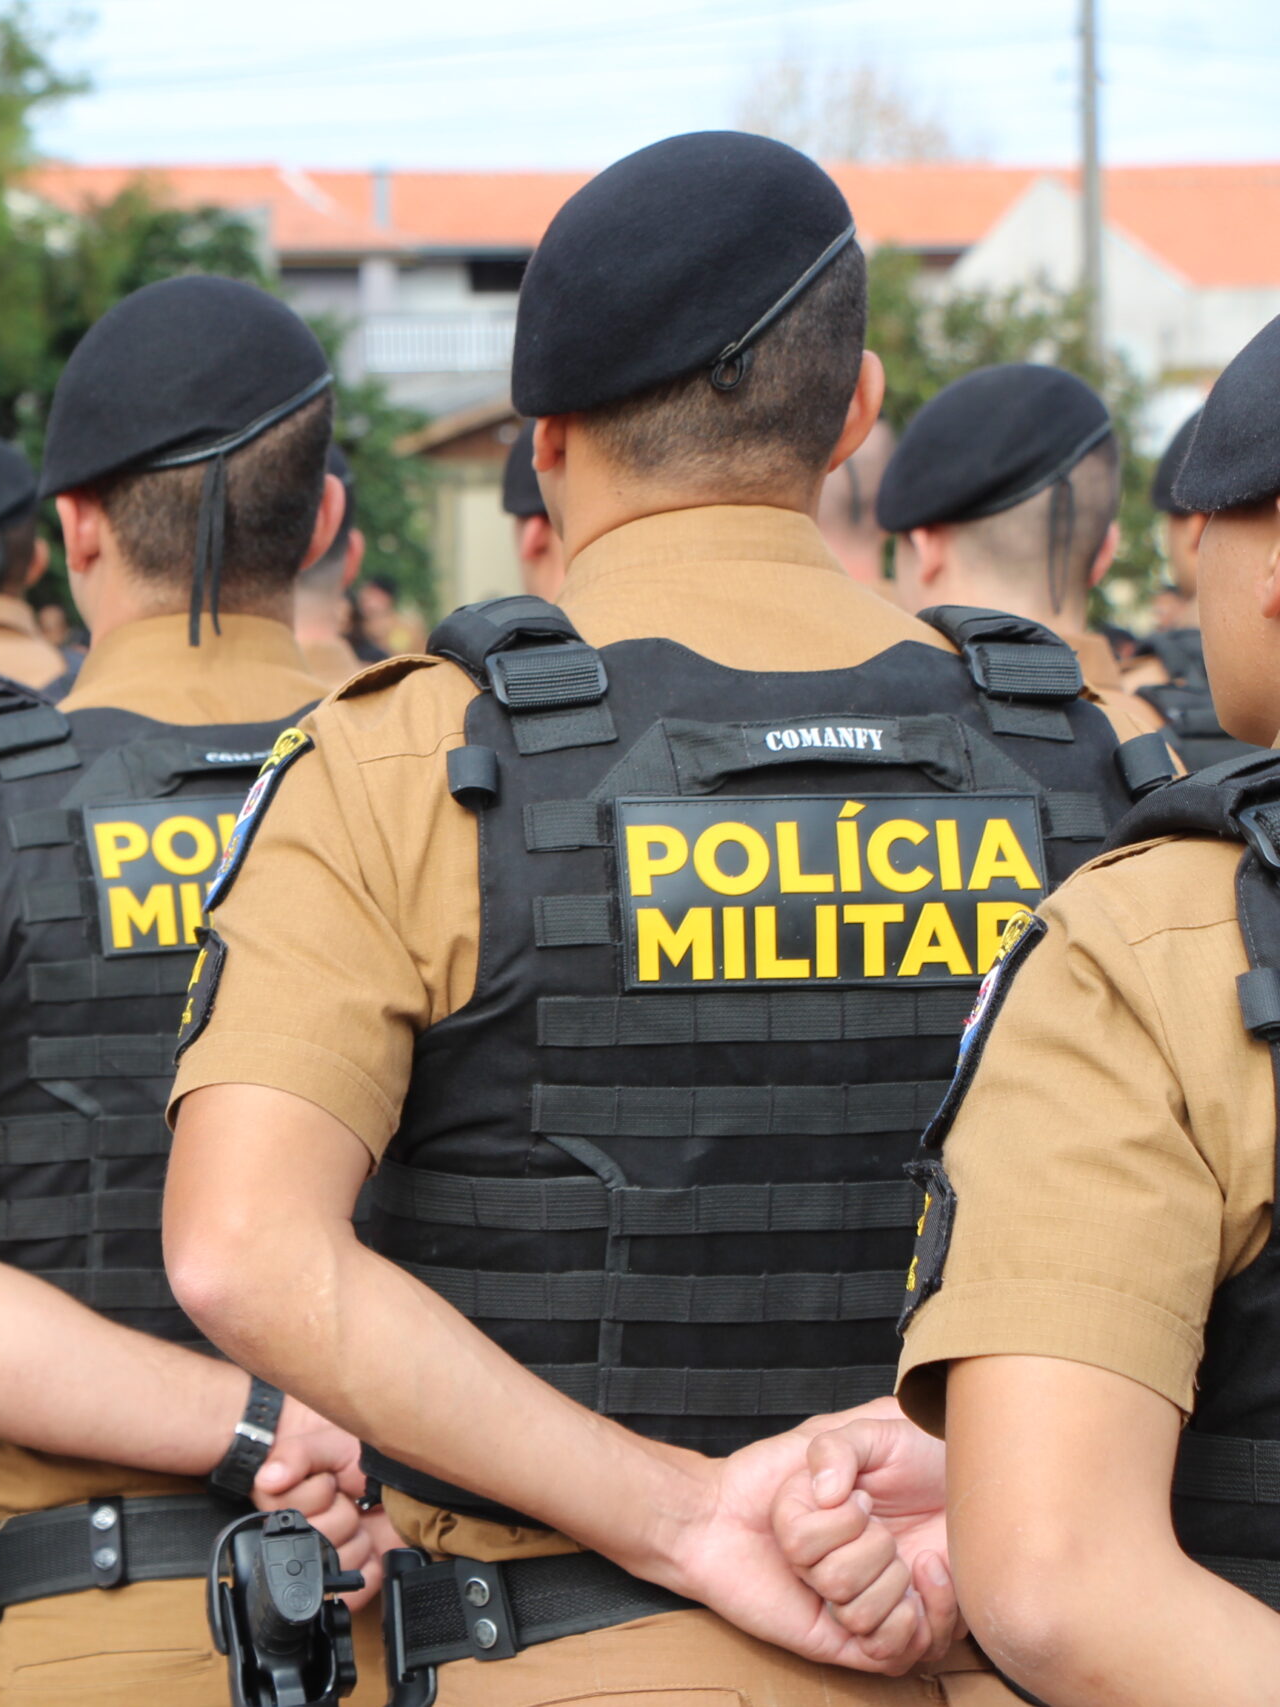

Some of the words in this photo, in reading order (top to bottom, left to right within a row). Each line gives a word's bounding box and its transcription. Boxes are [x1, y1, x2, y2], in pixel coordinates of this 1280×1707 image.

[765, 726, 883, 752] COMANFY
[626, 800, 1042, 896] POLÍCIA
[108, 882, 215, 948] MI
